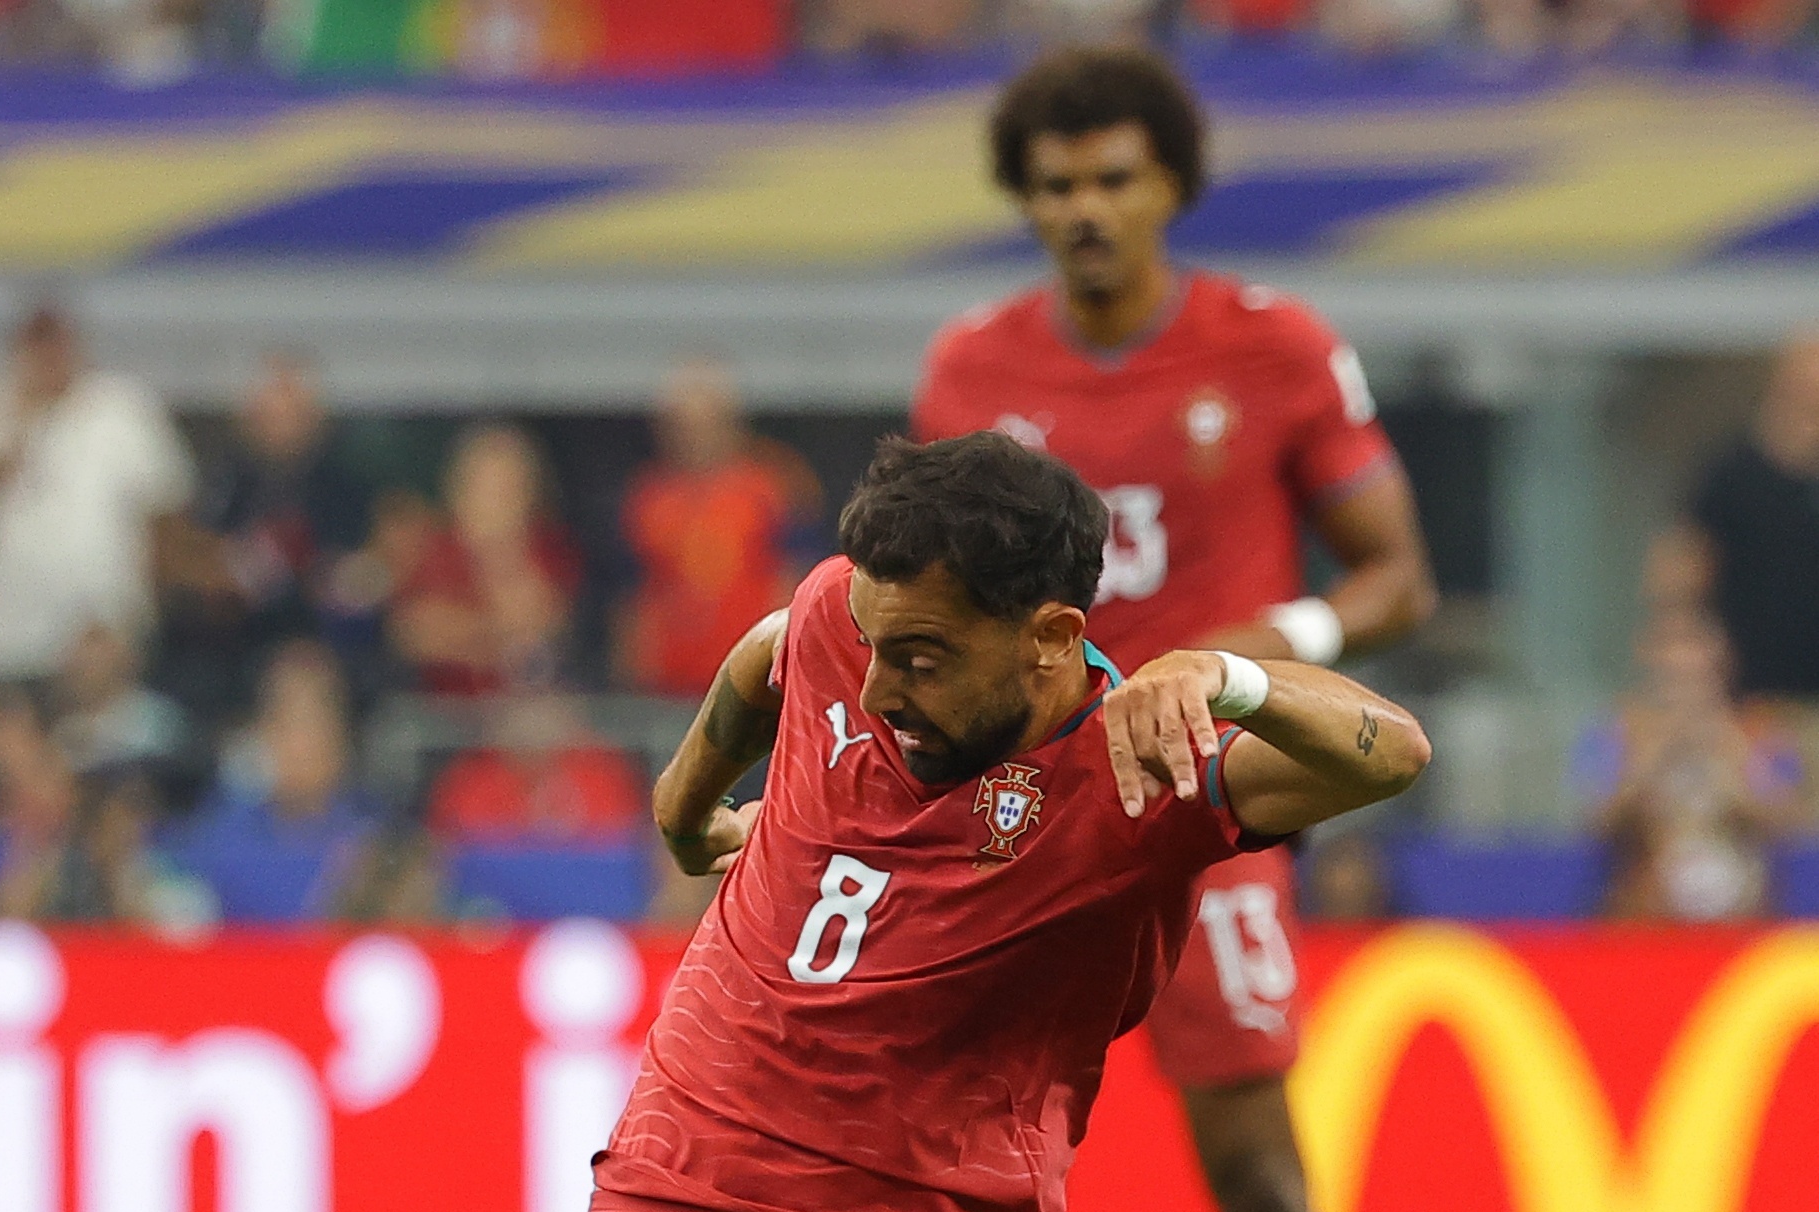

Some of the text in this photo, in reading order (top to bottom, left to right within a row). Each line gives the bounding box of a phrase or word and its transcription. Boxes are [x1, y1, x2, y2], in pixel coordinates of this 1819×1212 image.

[1093, 484, 1169, 602] 3
[787, 853, 893, 984] 8
[1197, 882, 1298, 1005] 13
